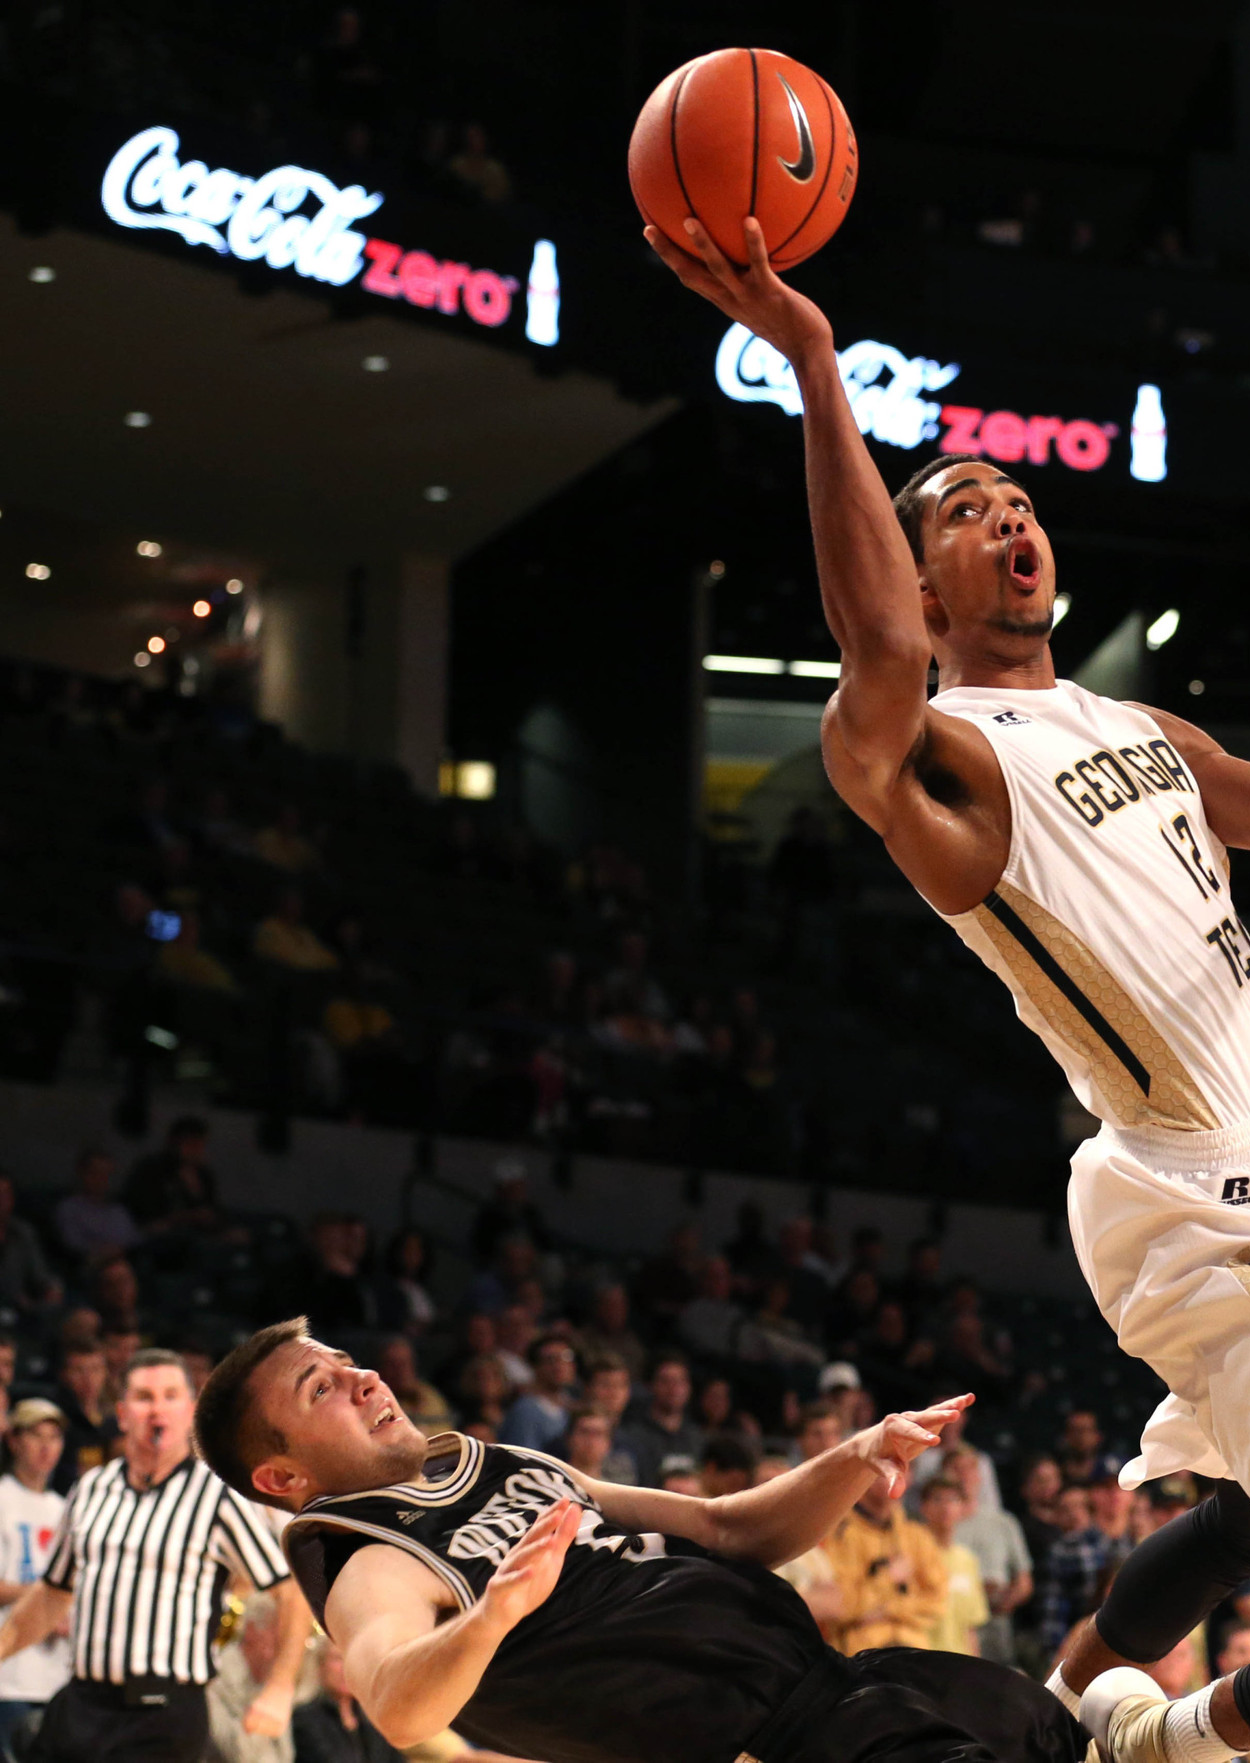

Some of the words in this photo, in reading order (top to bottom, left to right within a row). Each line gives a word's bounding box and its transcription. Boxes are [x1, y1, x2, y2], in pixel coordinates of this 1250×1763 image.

[362, 238, 512, 326] zero
[939, 405, 1110, 471] zero
[1054, 738, 1197, 829] GEOGIA
[1158, 812, 1222, 904] 12
[1221, 1176, 1250, 1200] R
